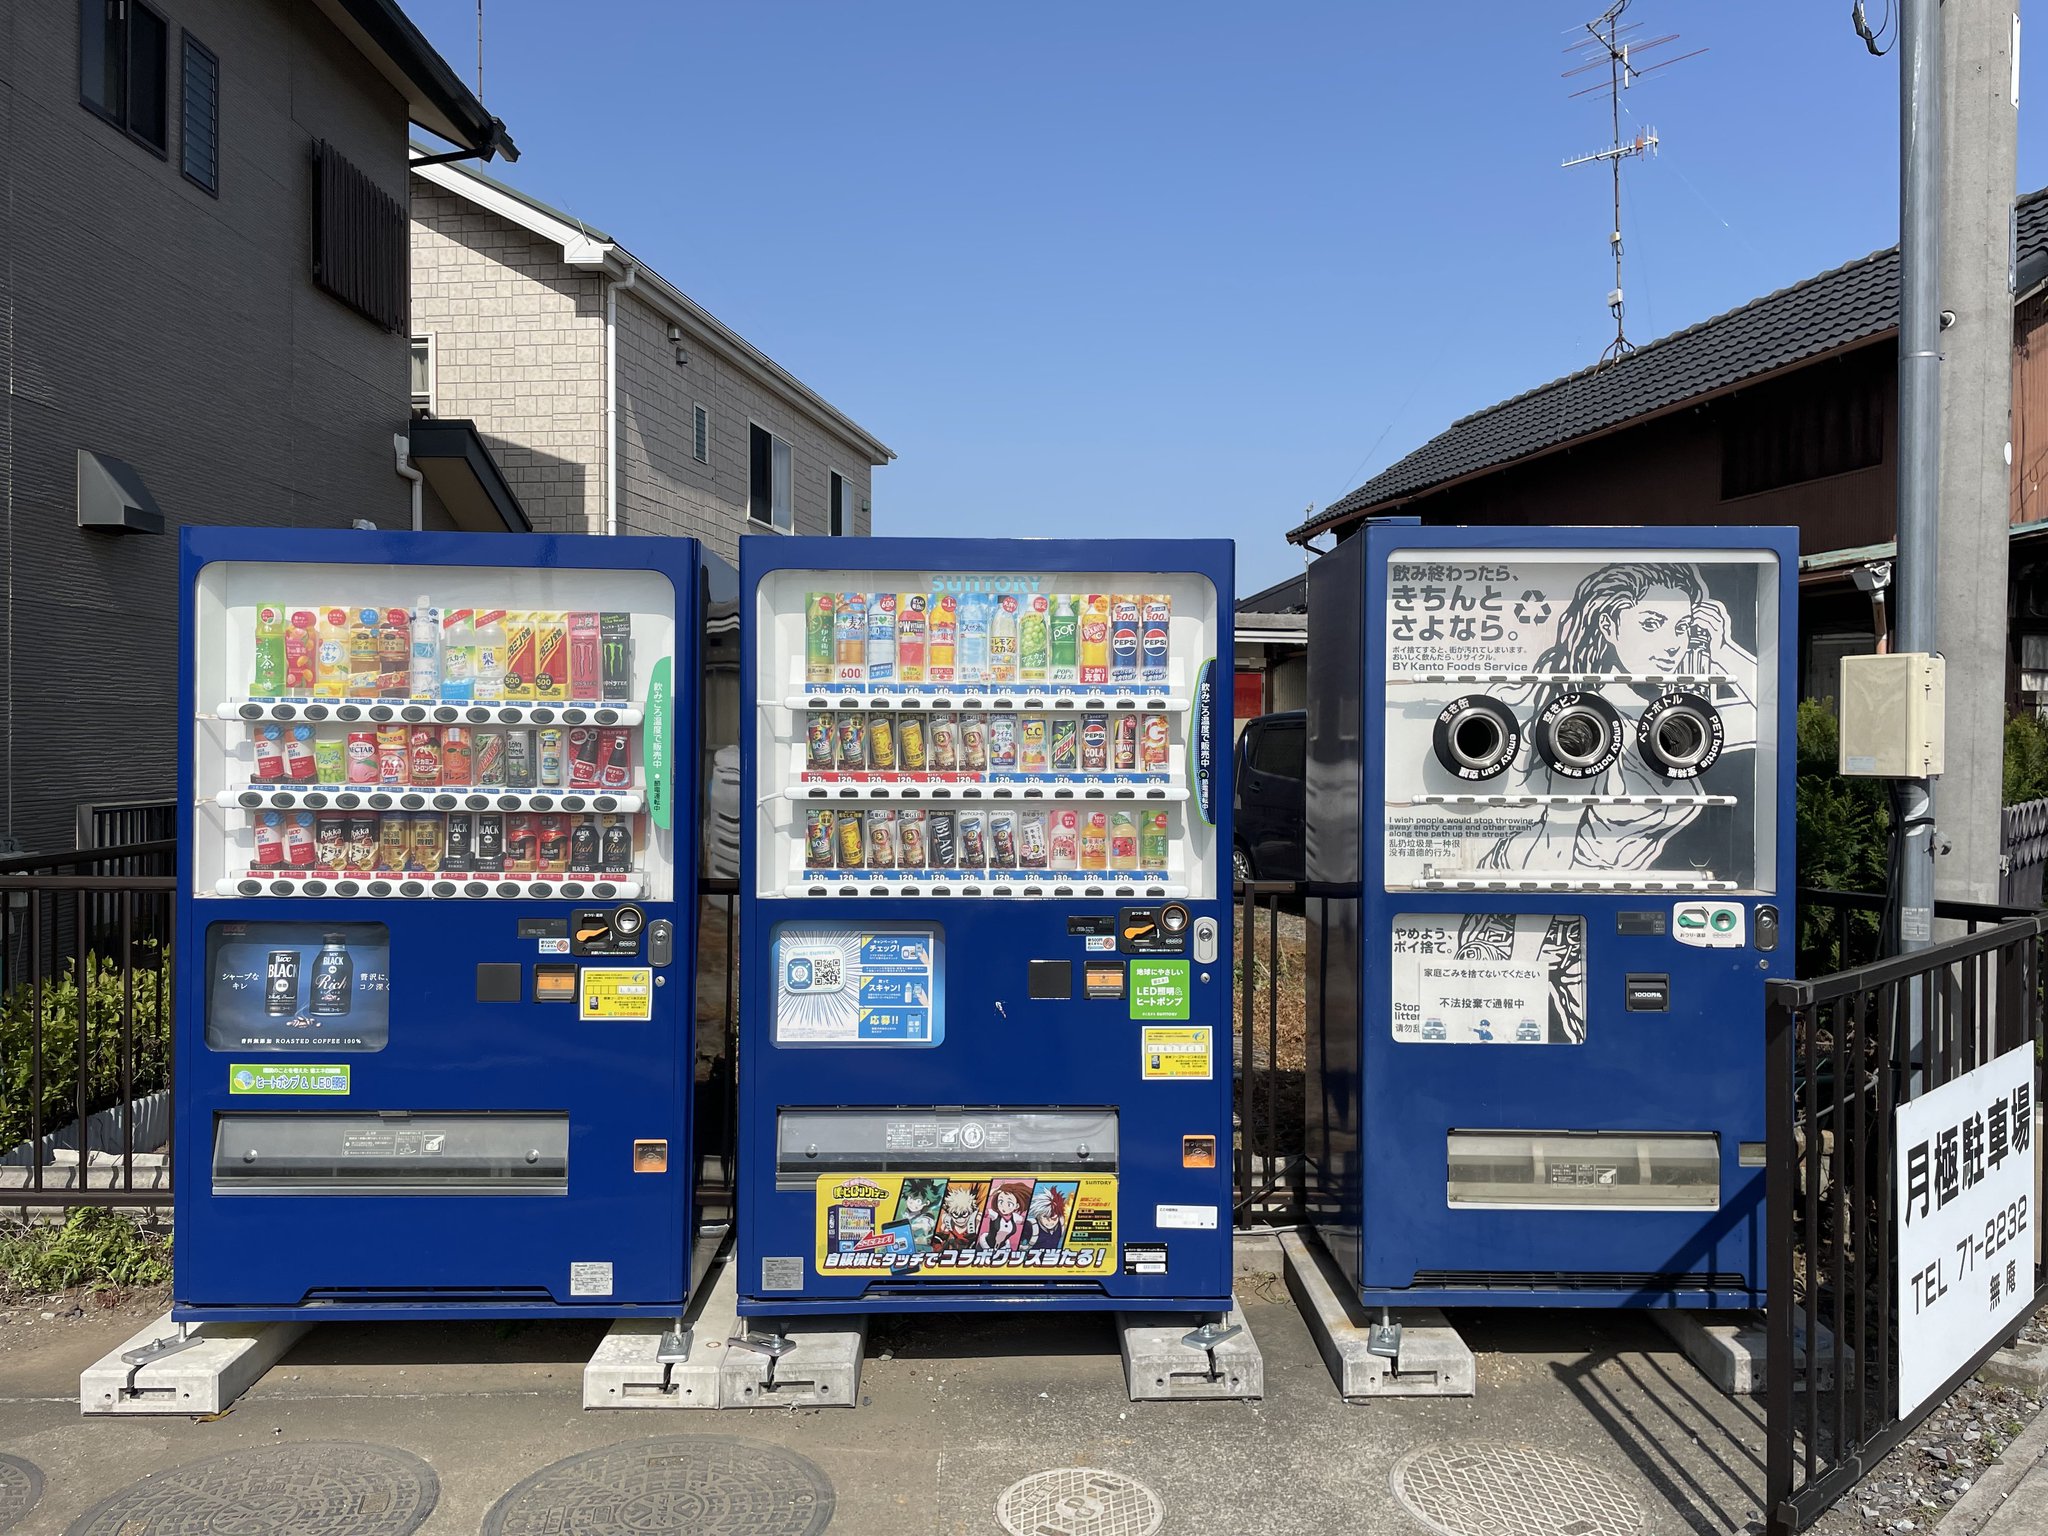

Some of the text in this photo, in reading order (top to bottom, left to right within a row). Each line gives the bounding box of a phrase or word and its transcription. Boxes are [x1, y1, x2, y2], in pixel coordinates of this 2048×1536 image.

[1393, 565, 1518, 581] 飲み終わったら、
[931, 575, 1042, 592] SUNTORY
[881, 600, 895, 608] 600
[1392, 585, 1502, 611] きちんと
[1392, 615, 1518, 641] さよなら。
[1393, 662, 1528, 671] BY Kanto Foods Service
[841, 668, 861, 678] 600
[1085, 674, 1105, 682] 元気!
[1440, 697, 1470, 724] 空き缶
[1543, 693, 1581, 723] 空きビン
[1639, 694, 1683, 743] ペットボトル
[653, 682, 663, 769] 飲みごろ温度で販売中
[1201, 682, 1211, 768] 飲みごろ温度で販売中
[1700, 714, 1723, 769] PET bottle
[1085, 748, 1104, 758] COLA
[1583, 720, 1621, 777] empty bottle
[1481, 733, 1516, 777] empty can
[1394, 816, 1414, 824] wish
[1416, 817, 1444, 825] people
[1446, 816, 1472, 824] would
[1474, 817, 1493, 825] stop
[1495, 816, 1534, 825] throwing
[1465, 823, 1481, 831] and
[1483, 823, 1506, 831] other
[1508, 823, 1532, 831] trash
[321, 828, 342, 839] Pokka
[1431, 831, 1450, 839] path
[935, 818, 954, 865] BLACK
[1395, 928, 1453, 940] やめよう、
[1394, 941, 1453, 954] ポイ捨て。
[322, 956, 344, 966] BLACK
[222, 972, 260, 981] シャープな
[360, 973, 389, 981] 贅沢に、
[1424, 968, 1540, 979] 家庭ごみを捨てないでください
[315, 974, 347, 990] Rich
[359, 983, 390, 991] コク深く
[868, 984, 901, 992] スキャン!
[1136, 986, 1183, 996] LED照明&
[1136, 997, 1183, 1006] ヒートポンプ
[1394, 1002, 1420, 1013] Stop
[1439, 997, 1525, 1009] 不法投棄で通報中
[869, 1015, 899, 1025] 応募!!
[256, 1076, 347, 1090] ヒートポンプ & LED照明
[1905, 1082, 2031, 1228] 月極駐車場
[823, 1248, 1106, 1269] 自販機にタッチでコラボグッズ当たる!
[1911, 1194, 2027, 1316] TEL 71-2232
